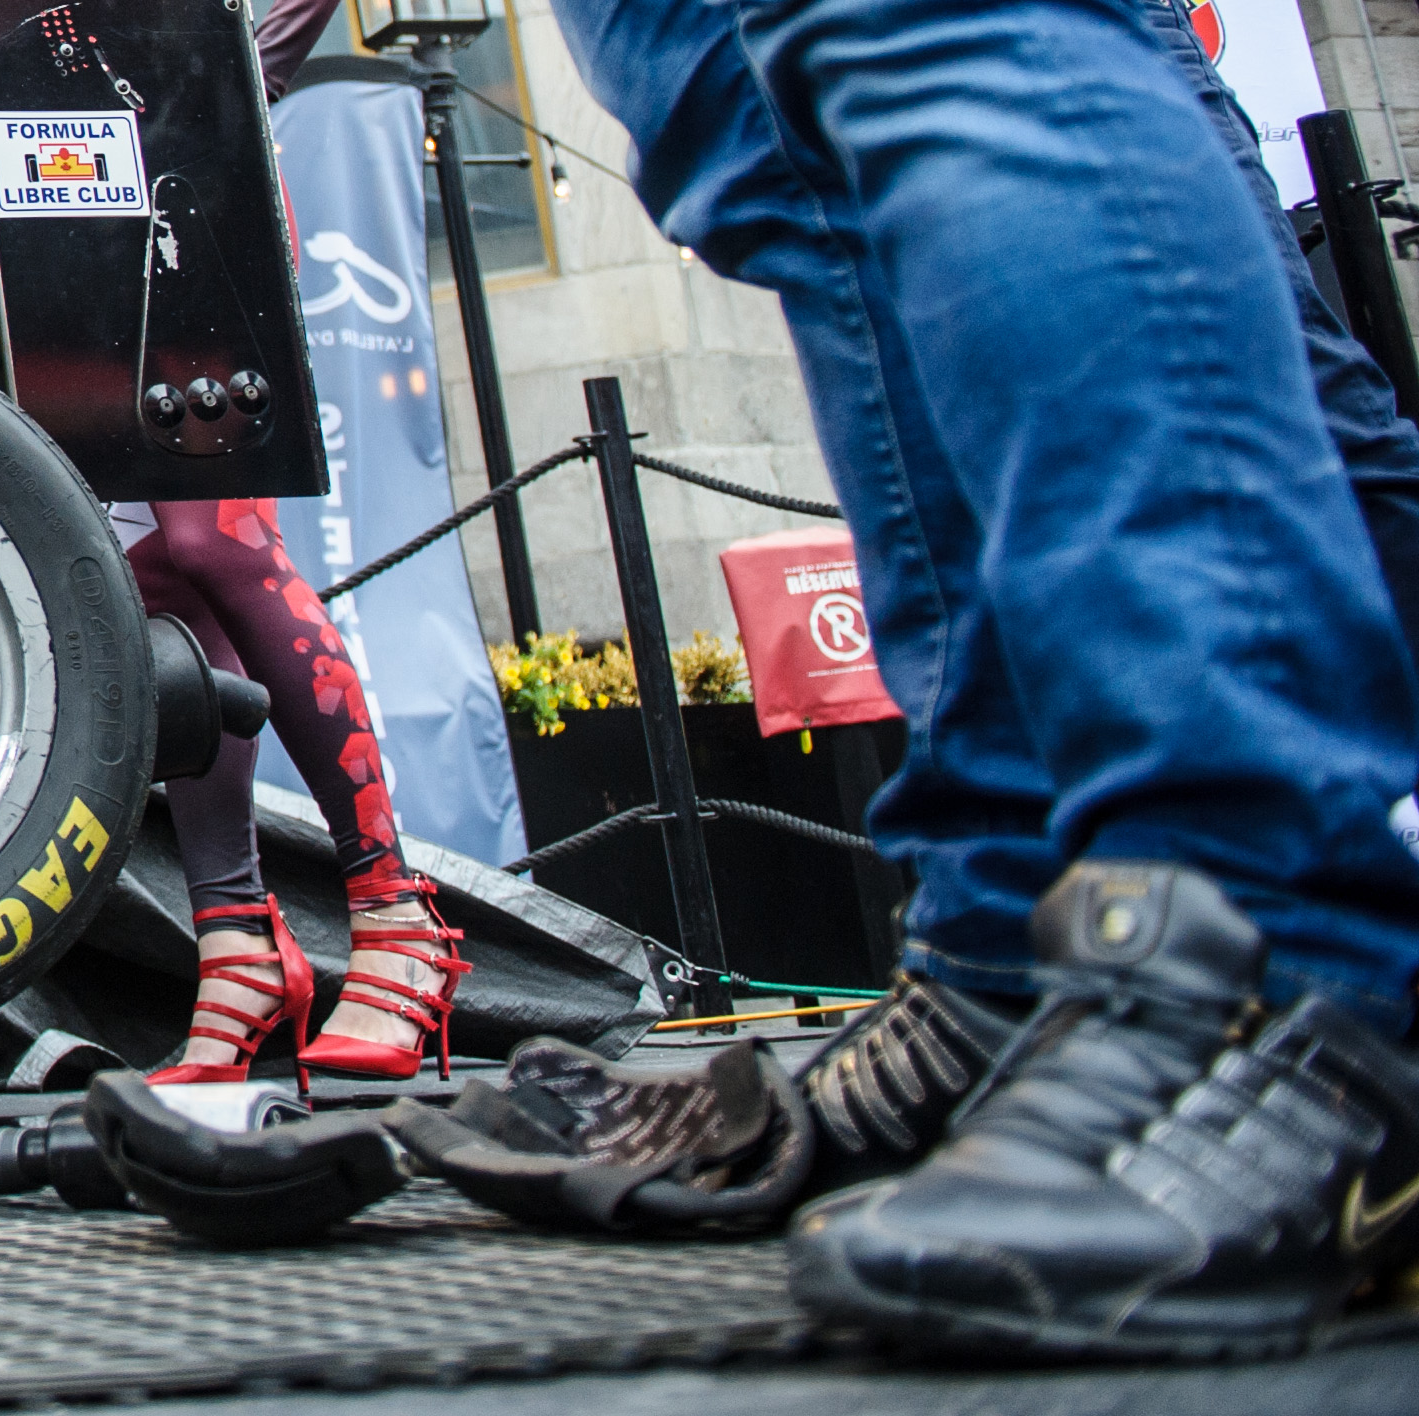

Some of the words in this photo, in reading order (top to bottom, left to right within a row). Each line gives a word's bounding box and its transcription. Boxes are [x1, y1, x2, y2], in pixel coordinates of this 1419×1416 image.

[7, 123, 115, 140] FORMULA
[5, 187, 70, 204] LIBRE
[77, 187, 137, 204] CLUB
